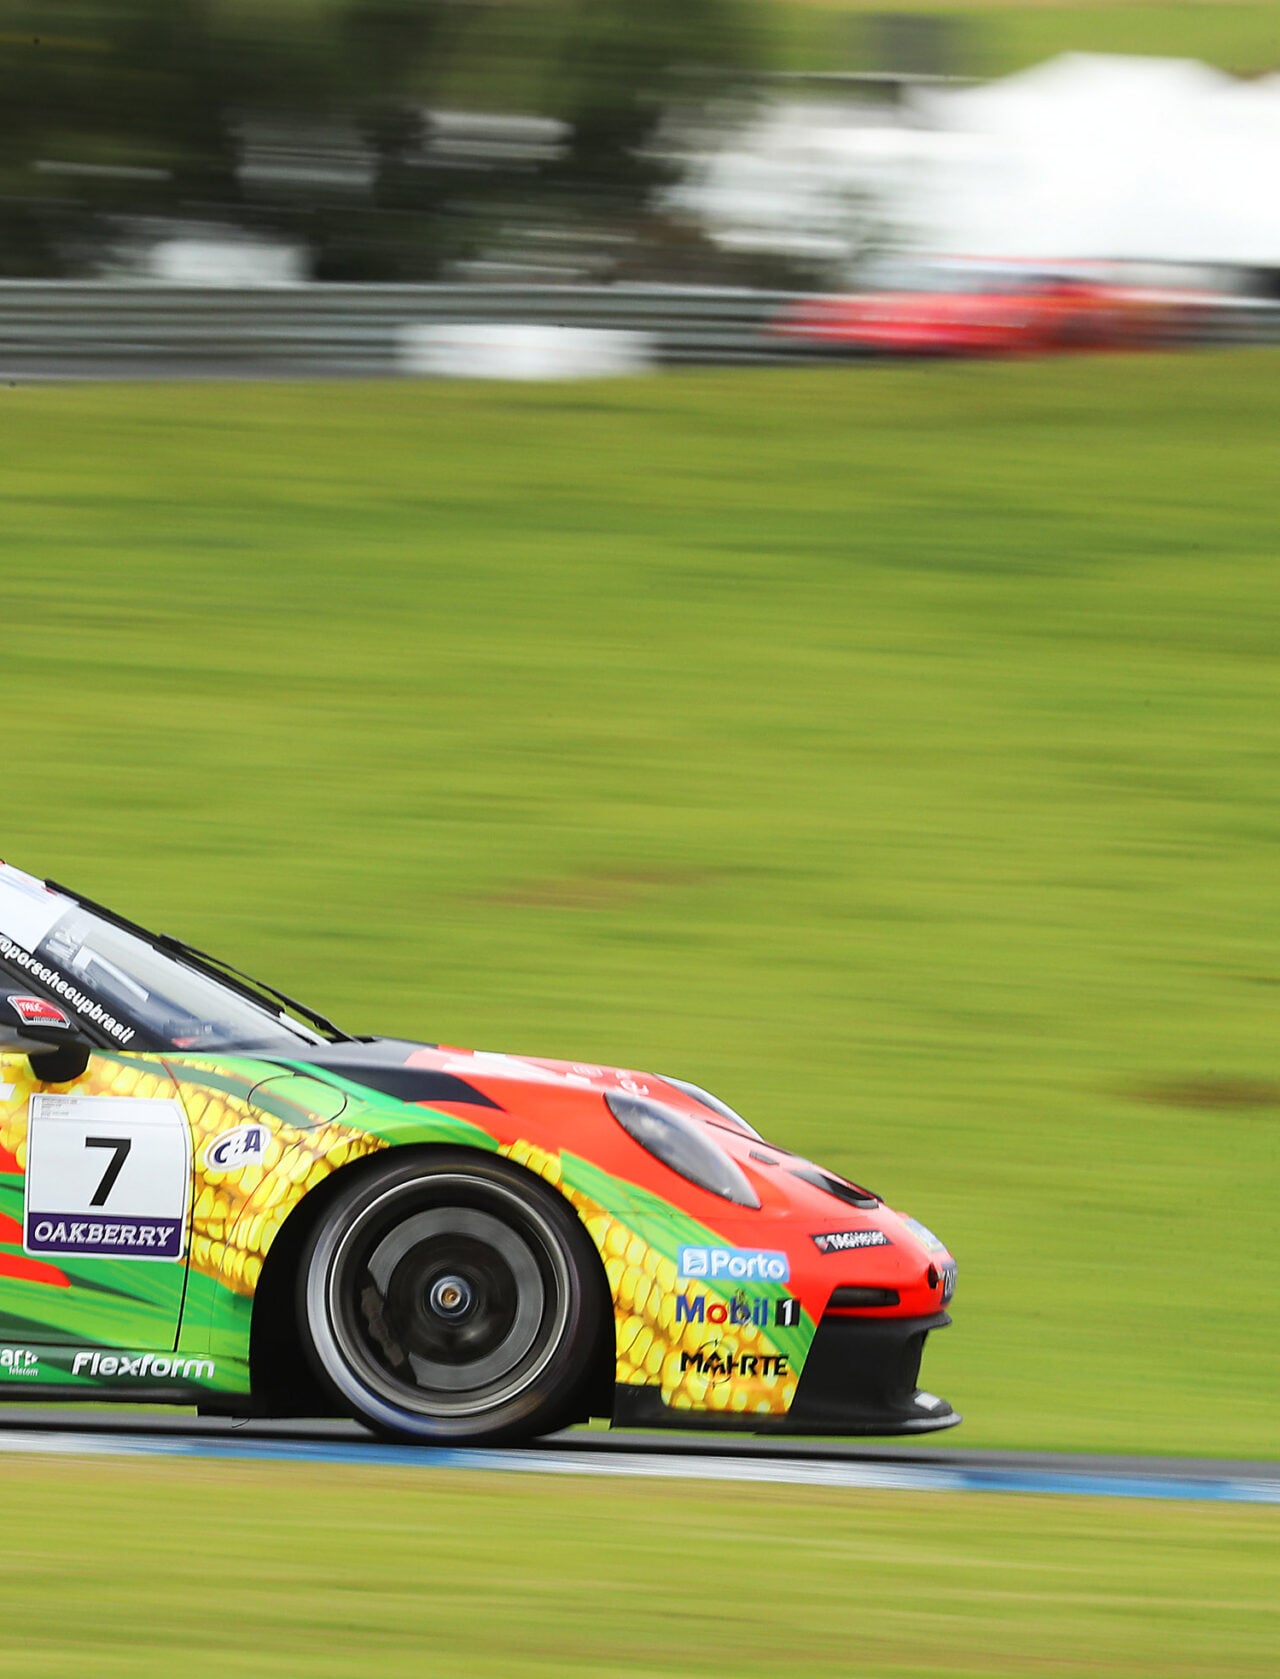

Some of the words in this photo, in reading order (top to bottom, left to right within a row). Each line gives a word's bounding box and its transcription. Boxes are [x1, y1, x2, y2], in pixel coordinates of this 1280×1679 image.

[85, 1136, 132, 1207] 7
[34, 1221, 174, 1247] OAKBERRY
[711, 1249, 786, 1279] Porto
[676, 1294, 768, 1327] Mobil
[71, 1352, 216, 1378] Flexform
